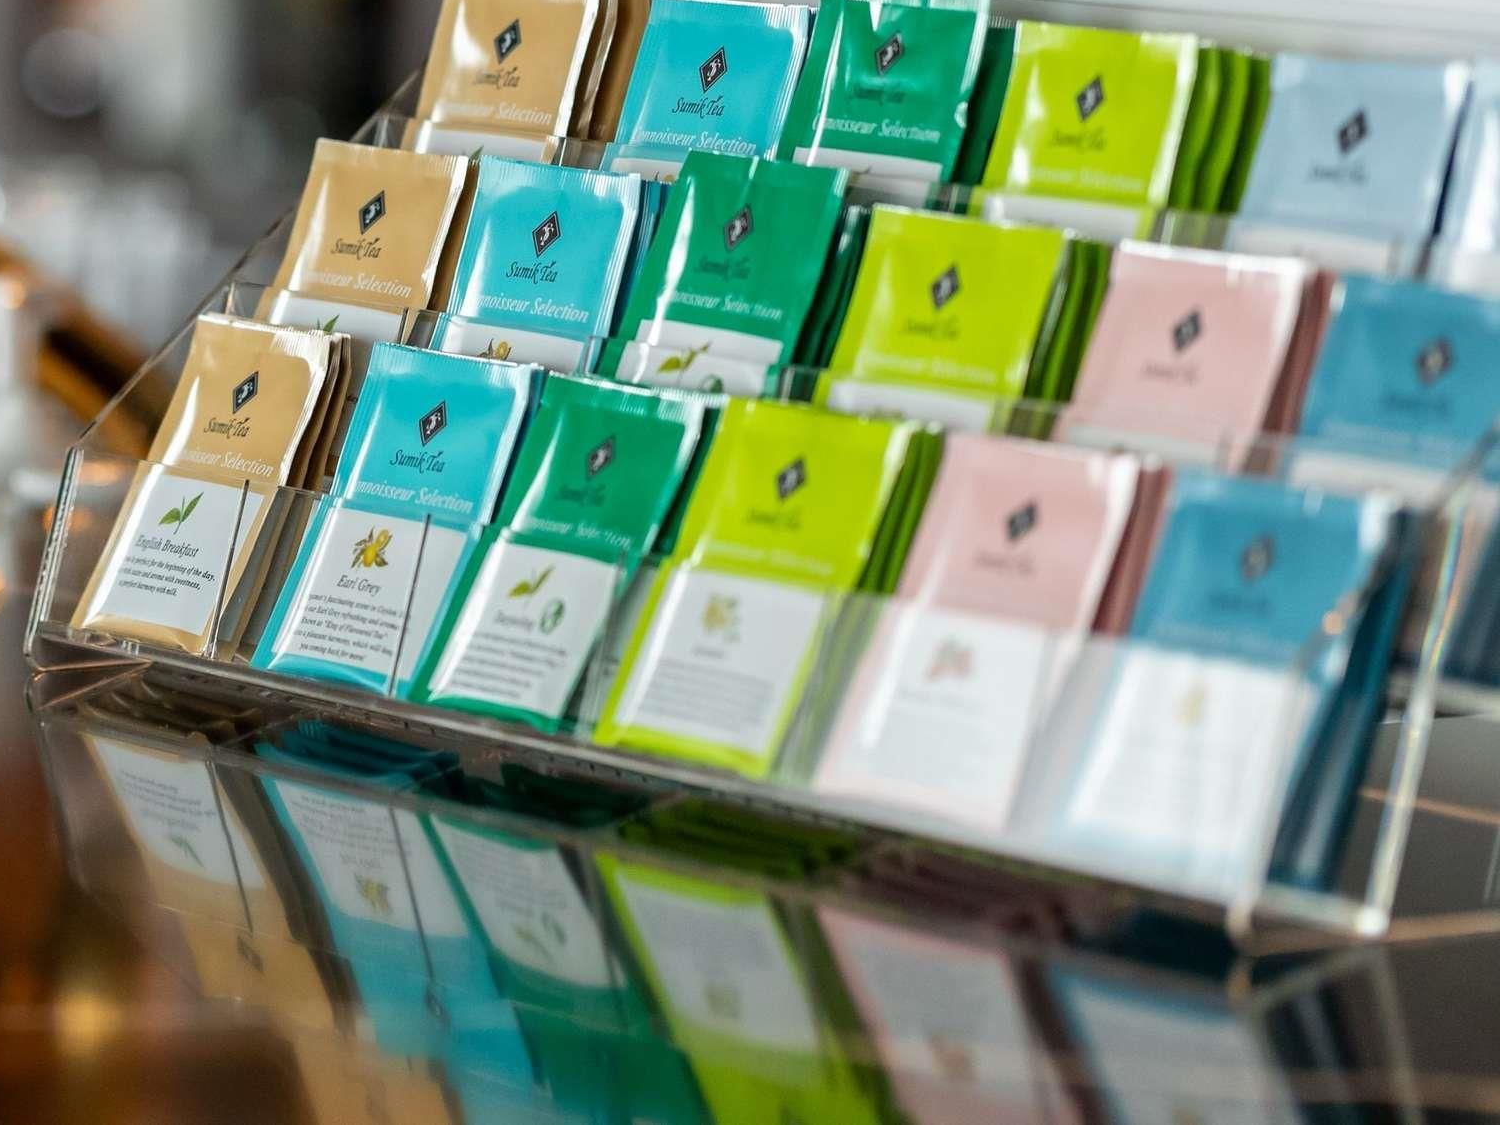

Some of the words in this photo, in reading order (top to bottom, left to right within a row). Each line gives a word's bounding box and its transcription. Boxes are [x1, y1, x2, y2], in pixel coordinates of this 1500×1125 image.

[672, 96, 708, 119] Sumik
[706, 95, 725, 117] Tea
[696, 130, 757, 155] Selection
[330, 237, 365, 261] Sumik
[364, 237, 382, 259] Tea
[353, 272, 412, 298] Selection
[506, 261, 541, 285] Sumik
[540, 261, 558, 283] Tea
[530, 297, 590, 323] Selection
[203, 417, 237, 439] Sumik
[233, 417, 251, 438] Tea
[220, 451, 274, 477] Selection
[389, 449, 427, 474] Sumik
[426, 451, 445, 473] Tea
[415, 487, 474, 514] Selection
[161, 539, 199, 558] Breakfast
[336, 574, 357, 589] Earl
[357, 579, 381, 596] Grey
